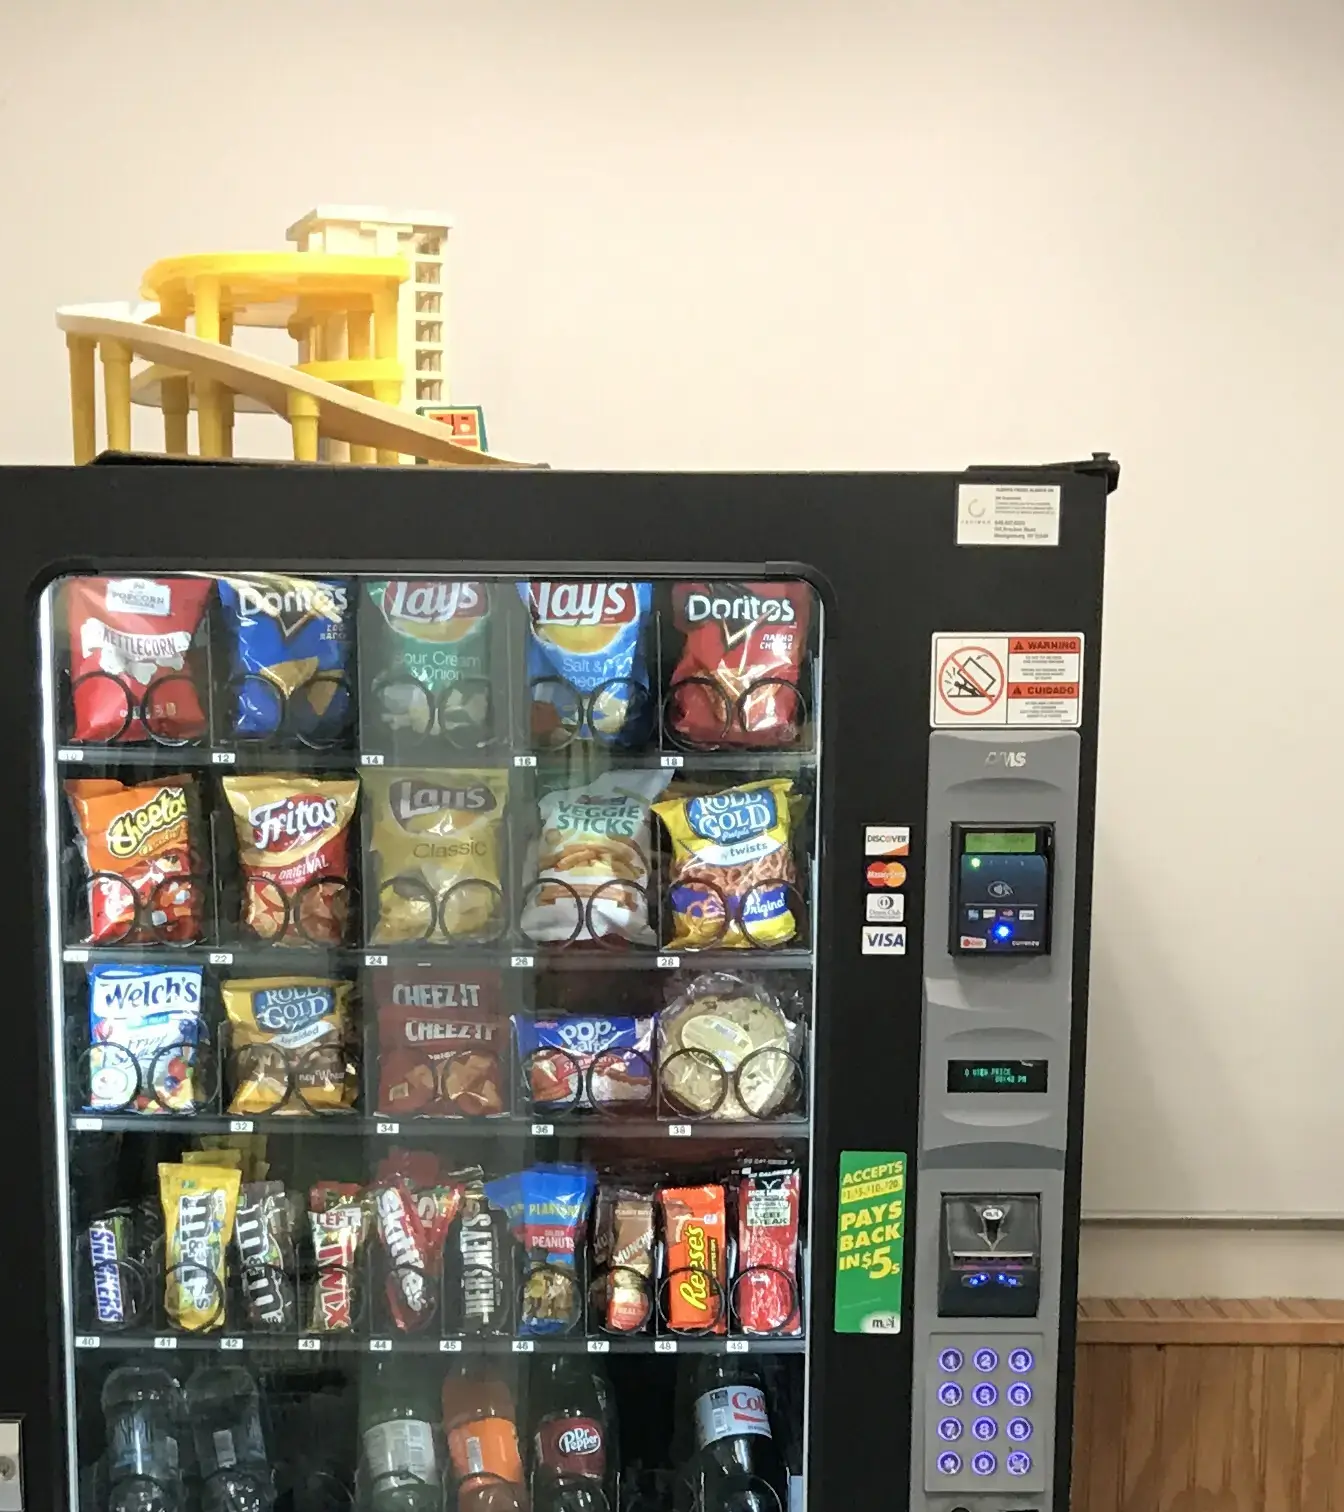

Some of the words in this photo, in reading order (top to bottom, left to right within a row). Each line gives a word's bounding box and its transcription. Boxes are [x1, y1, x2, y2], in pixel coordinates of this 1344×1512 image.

[687, 594, 795, 622] Doritos
[1027, 641, 1076, 650] WARNING
[433, 651, 480, 668] Cream
[562, 658, 592, 673] Salt
[1027, 686, 1075, 695] CUIDADO
[556, 801, 640, 819] VEGGIE
[248, 798, 338, 850] Fritos
[556, 816, 635, 838] STICKS
[698, 803, 771, 838] GOLD
[413, 838, 488, 859] Classic
[866, 834, 906, 843] DISCOVER
[729, 841, 769, 858] twists
[865, 932, 904, 947] VISA
[105, 976, 198, 1009] Welch's
[258, 996, 328, 1029] GOLD
[842, 1160, 903, 1185] ACCEPTS
[529, 1202, 579, 1218] PLAN
[840, 1200, 902, 1231] PAYS
[839, 1223, 901, 1252] BACK
[679, 1224, 708, 1311] Reese's
[839, 1253, 860, 1271] IN
[90, 1230, 124, 1322] SNICKERS
[563, 1433, 600, 1452] Pepper
[575, 1427, 590, 1439] Dr
